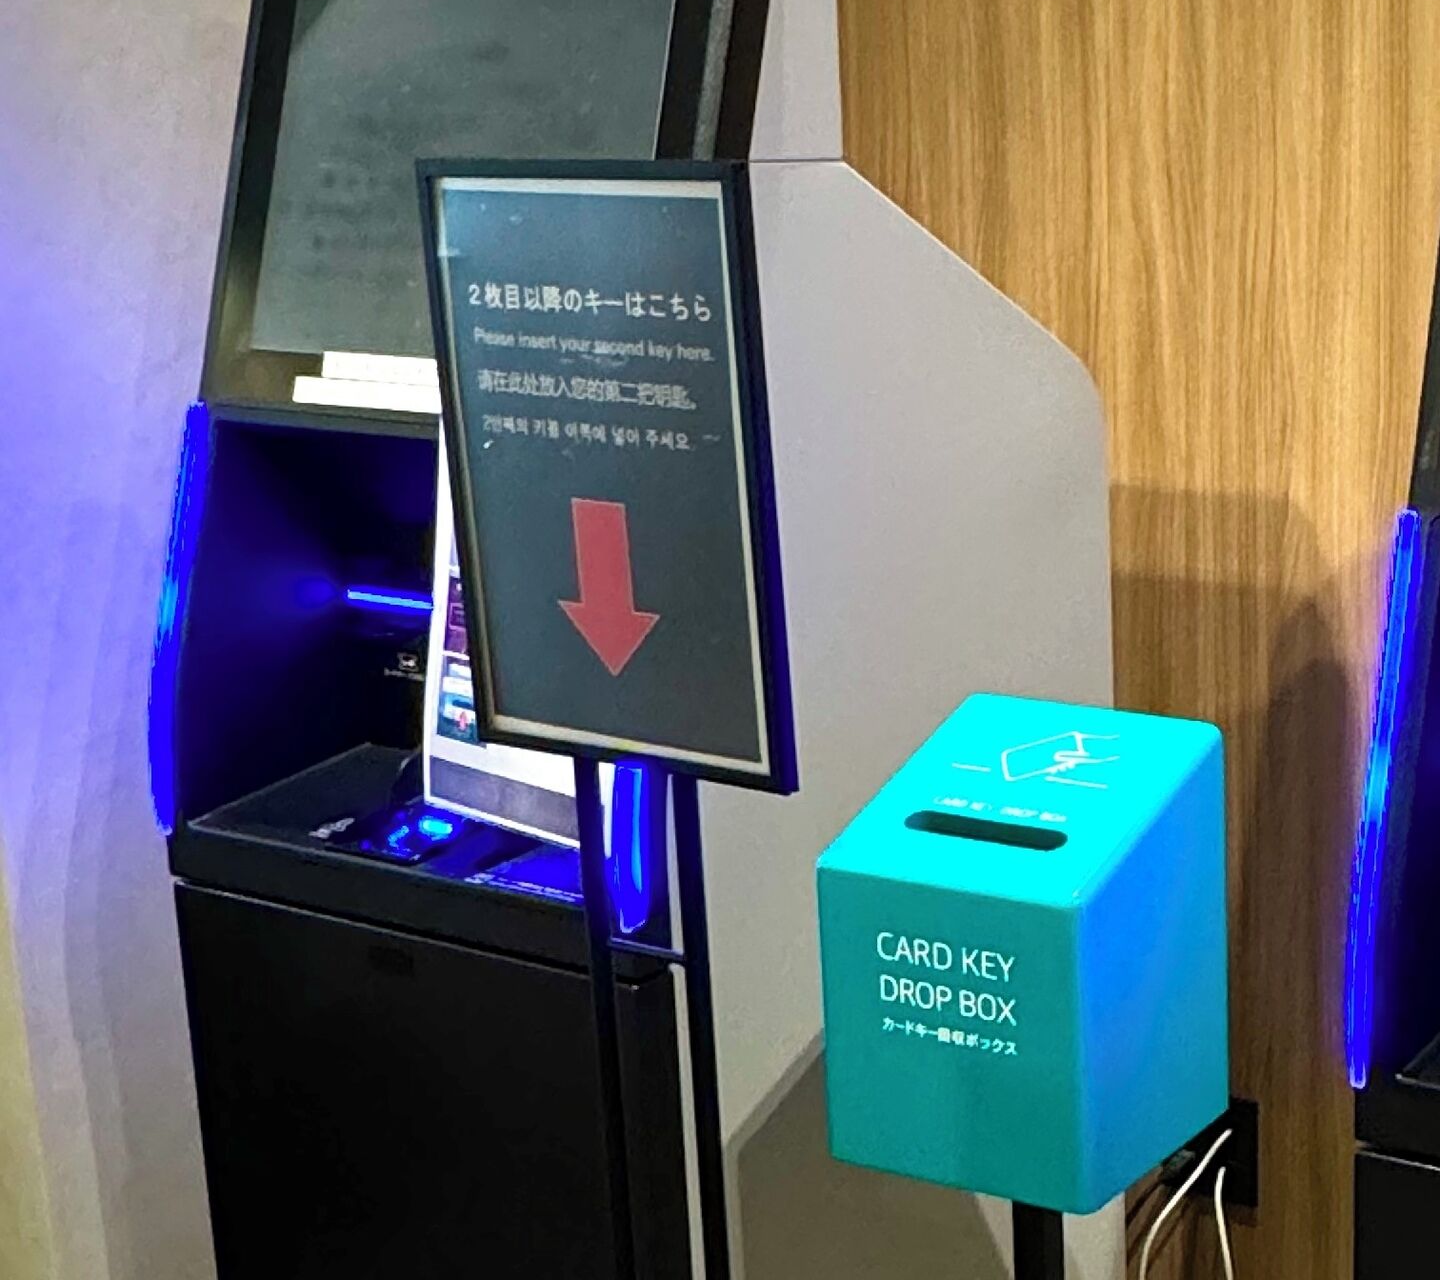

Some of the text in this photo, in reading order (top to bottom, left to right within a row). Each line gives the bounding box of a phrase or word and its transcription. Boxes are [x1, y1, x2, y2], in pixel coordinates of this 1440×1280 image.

[468, 283, 711, 321] 2枚目以降のキーはこちら
[474, 327, 715, 363] Please insert your second key here.
[877, 932, 1015, 982] CARD KEY
[880, 974, 1017, 1027] DROP BOX
